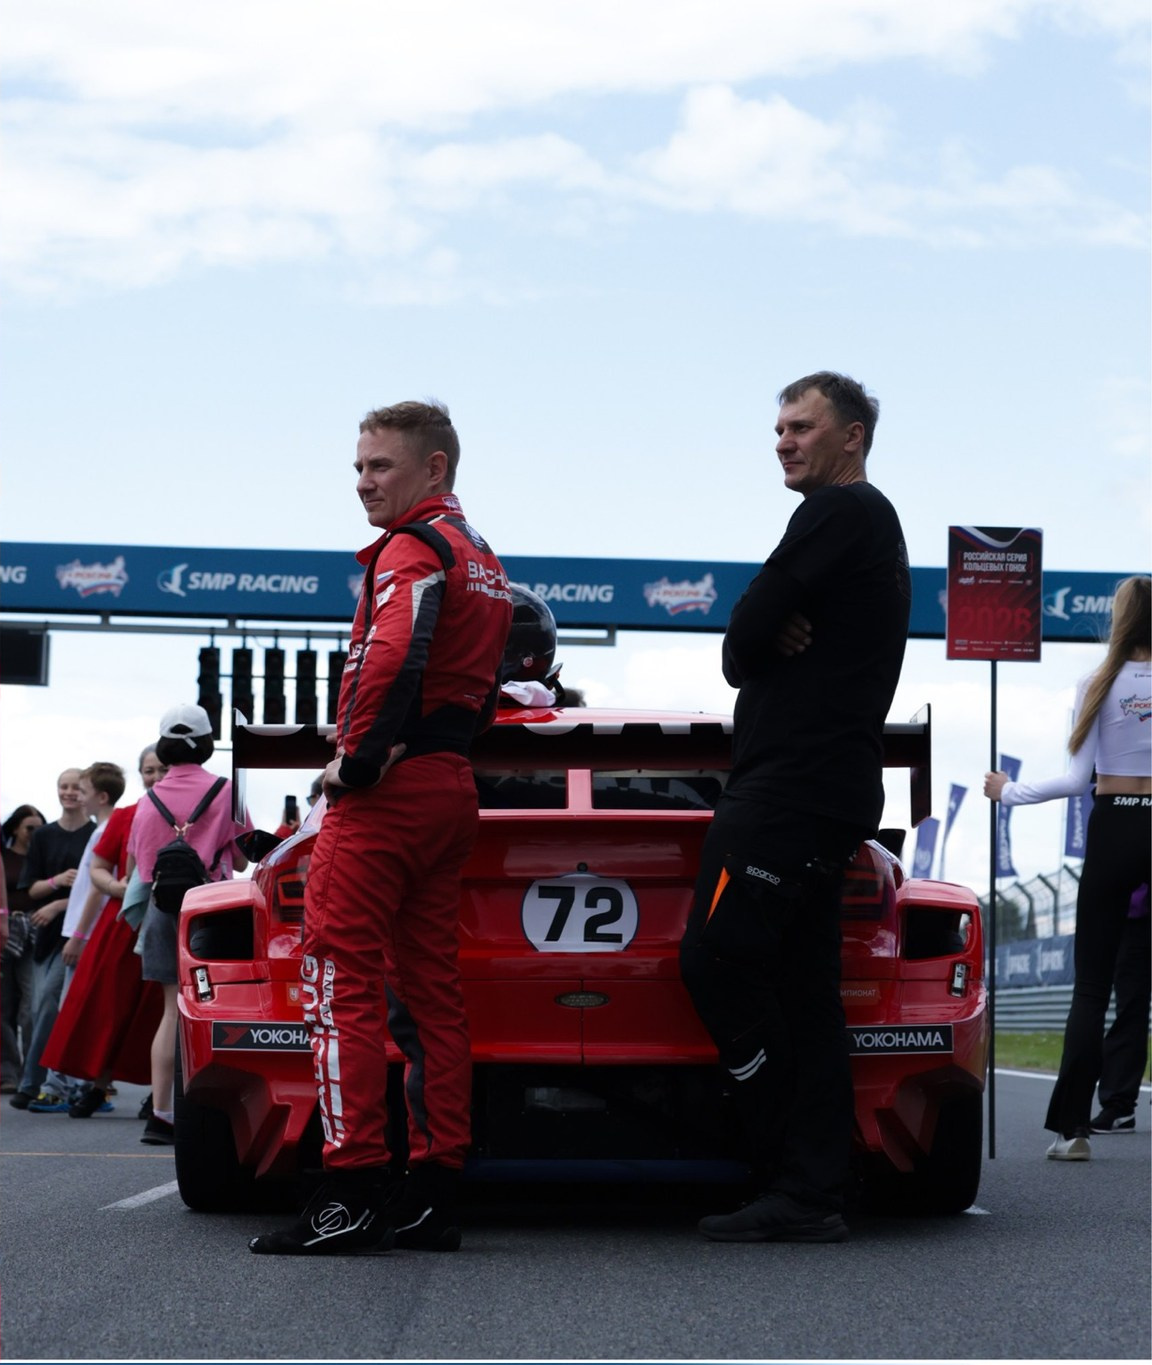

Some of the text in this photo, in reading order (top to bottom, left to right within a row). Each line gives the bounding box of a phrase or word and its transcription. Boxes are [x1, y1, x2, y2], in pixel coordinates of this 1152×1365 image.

[963, 551, 1028, 563] РОССИЙСКАЯ СЕРИЯ
[963, 562, 1027, 572] КОЛЬЦЕВЫХ ГОНОК
[188, 572, 319, 594] SMP RACING
[536, 582, 614, 603] RACING
[1113, 796, 1139, 807] SMP
[745, 865, 781, 885] sparco
[537, 885, 624, 943] 72
[840, 987, 877, 998] МПИОНАТ
[250, 1028, 311, 1046] YOKOHA
[853, 1031, 945, 1048] YOKOHAMA
